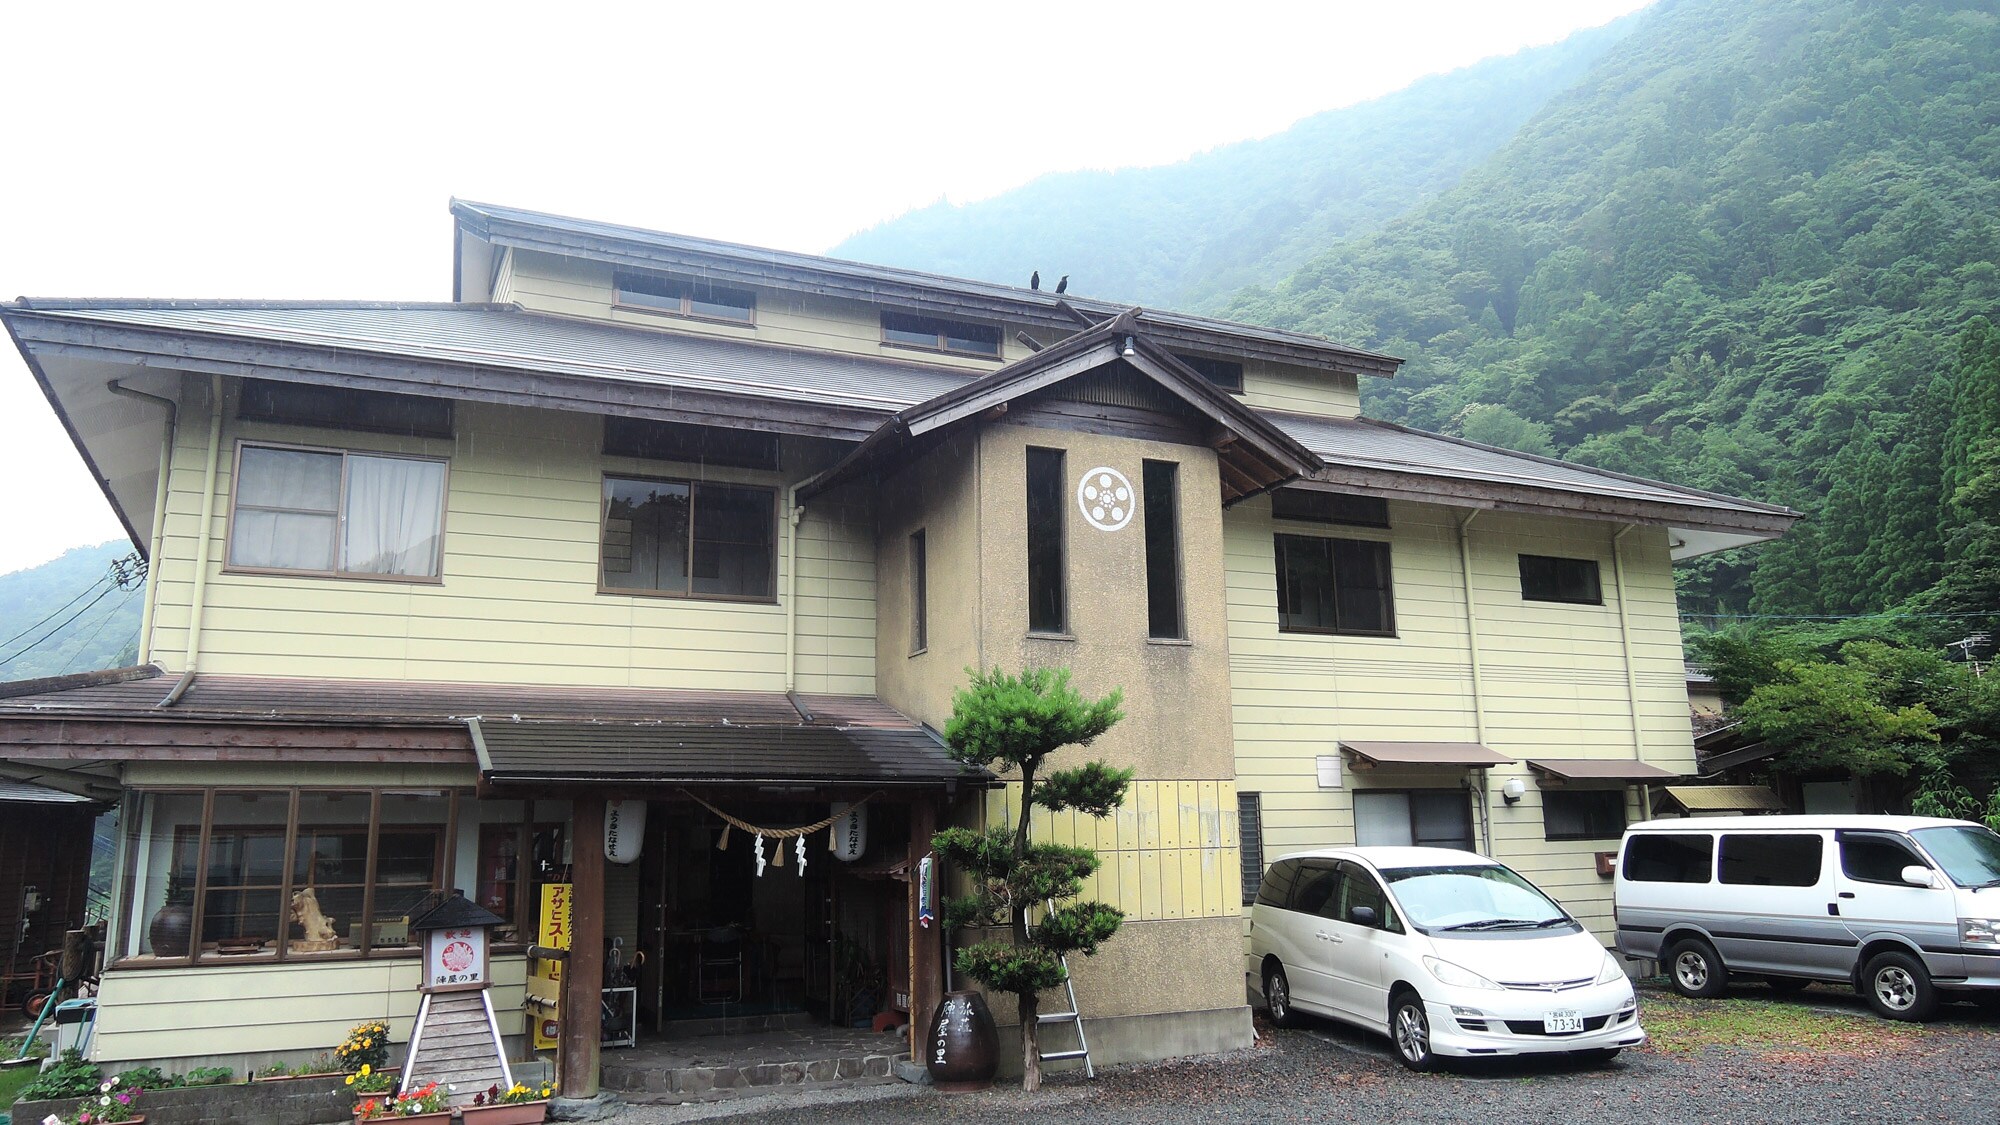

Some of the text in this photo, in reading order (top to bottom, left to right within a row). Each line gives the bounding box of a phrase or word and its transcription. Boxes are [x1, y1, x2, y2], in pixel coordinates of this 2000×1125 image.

[435, 972, 480, 985] 陣屋の里
[1553, 1018, 1581, 1031] 73-34
